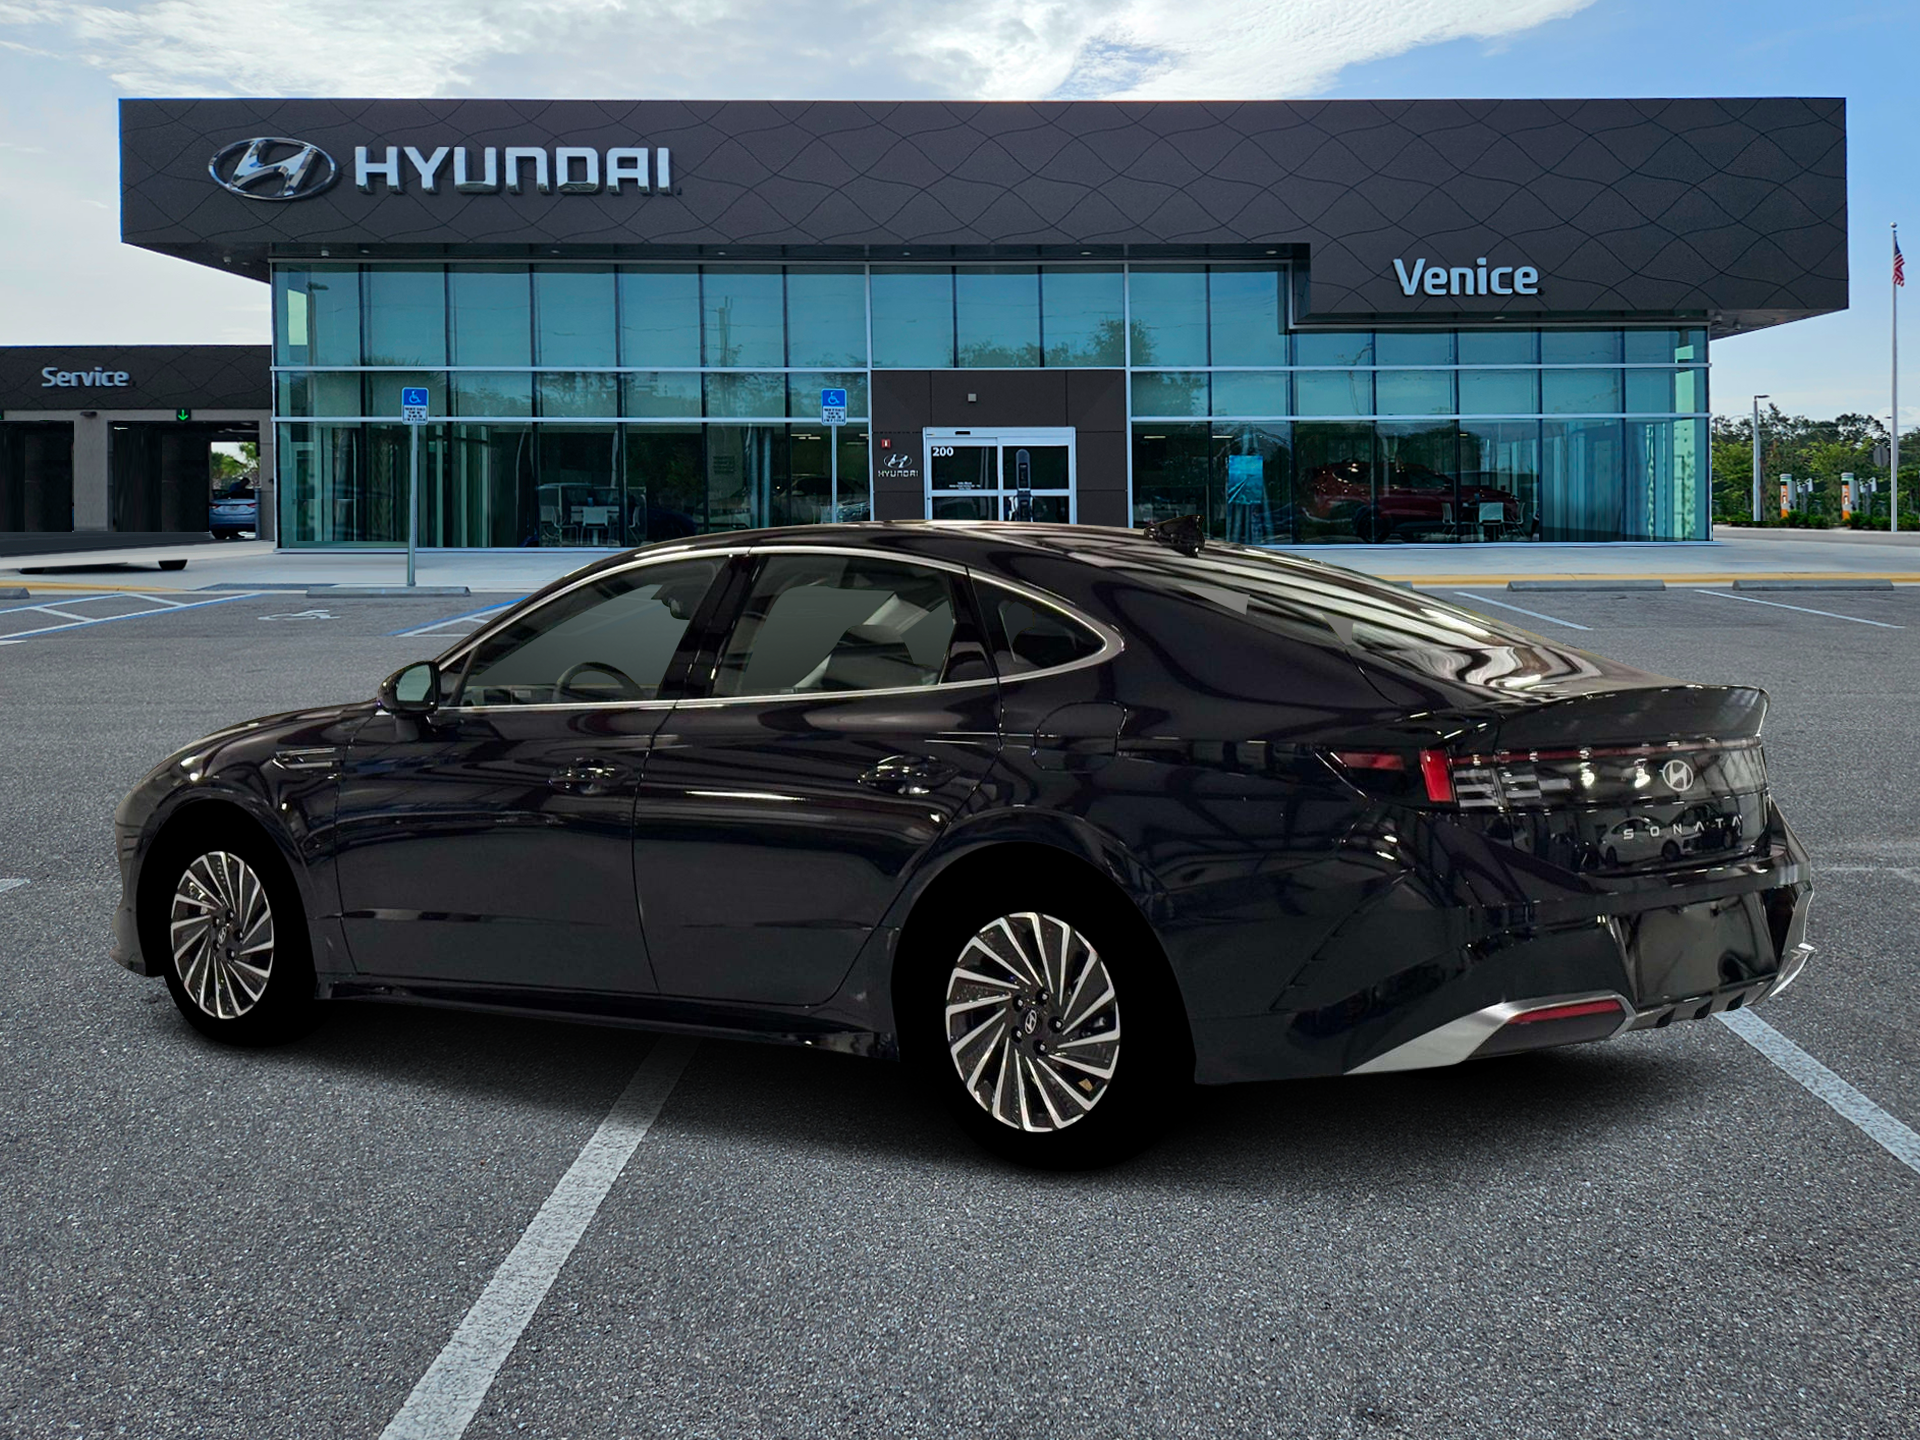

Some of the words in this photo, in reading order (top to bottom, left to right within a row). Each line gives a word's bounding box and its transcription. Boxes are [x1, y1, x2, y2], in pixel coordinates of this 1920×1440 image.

[355, 146, 670, 193] HYUNDAI
[1392, 257, 1539, 296] Venice
[41, 366, 130, 387] Service
[932, 446, 954, 457] 200
[877, 469, 919, 478] HYUNDAI
[1623, 815, 1741, 840] SONATA
